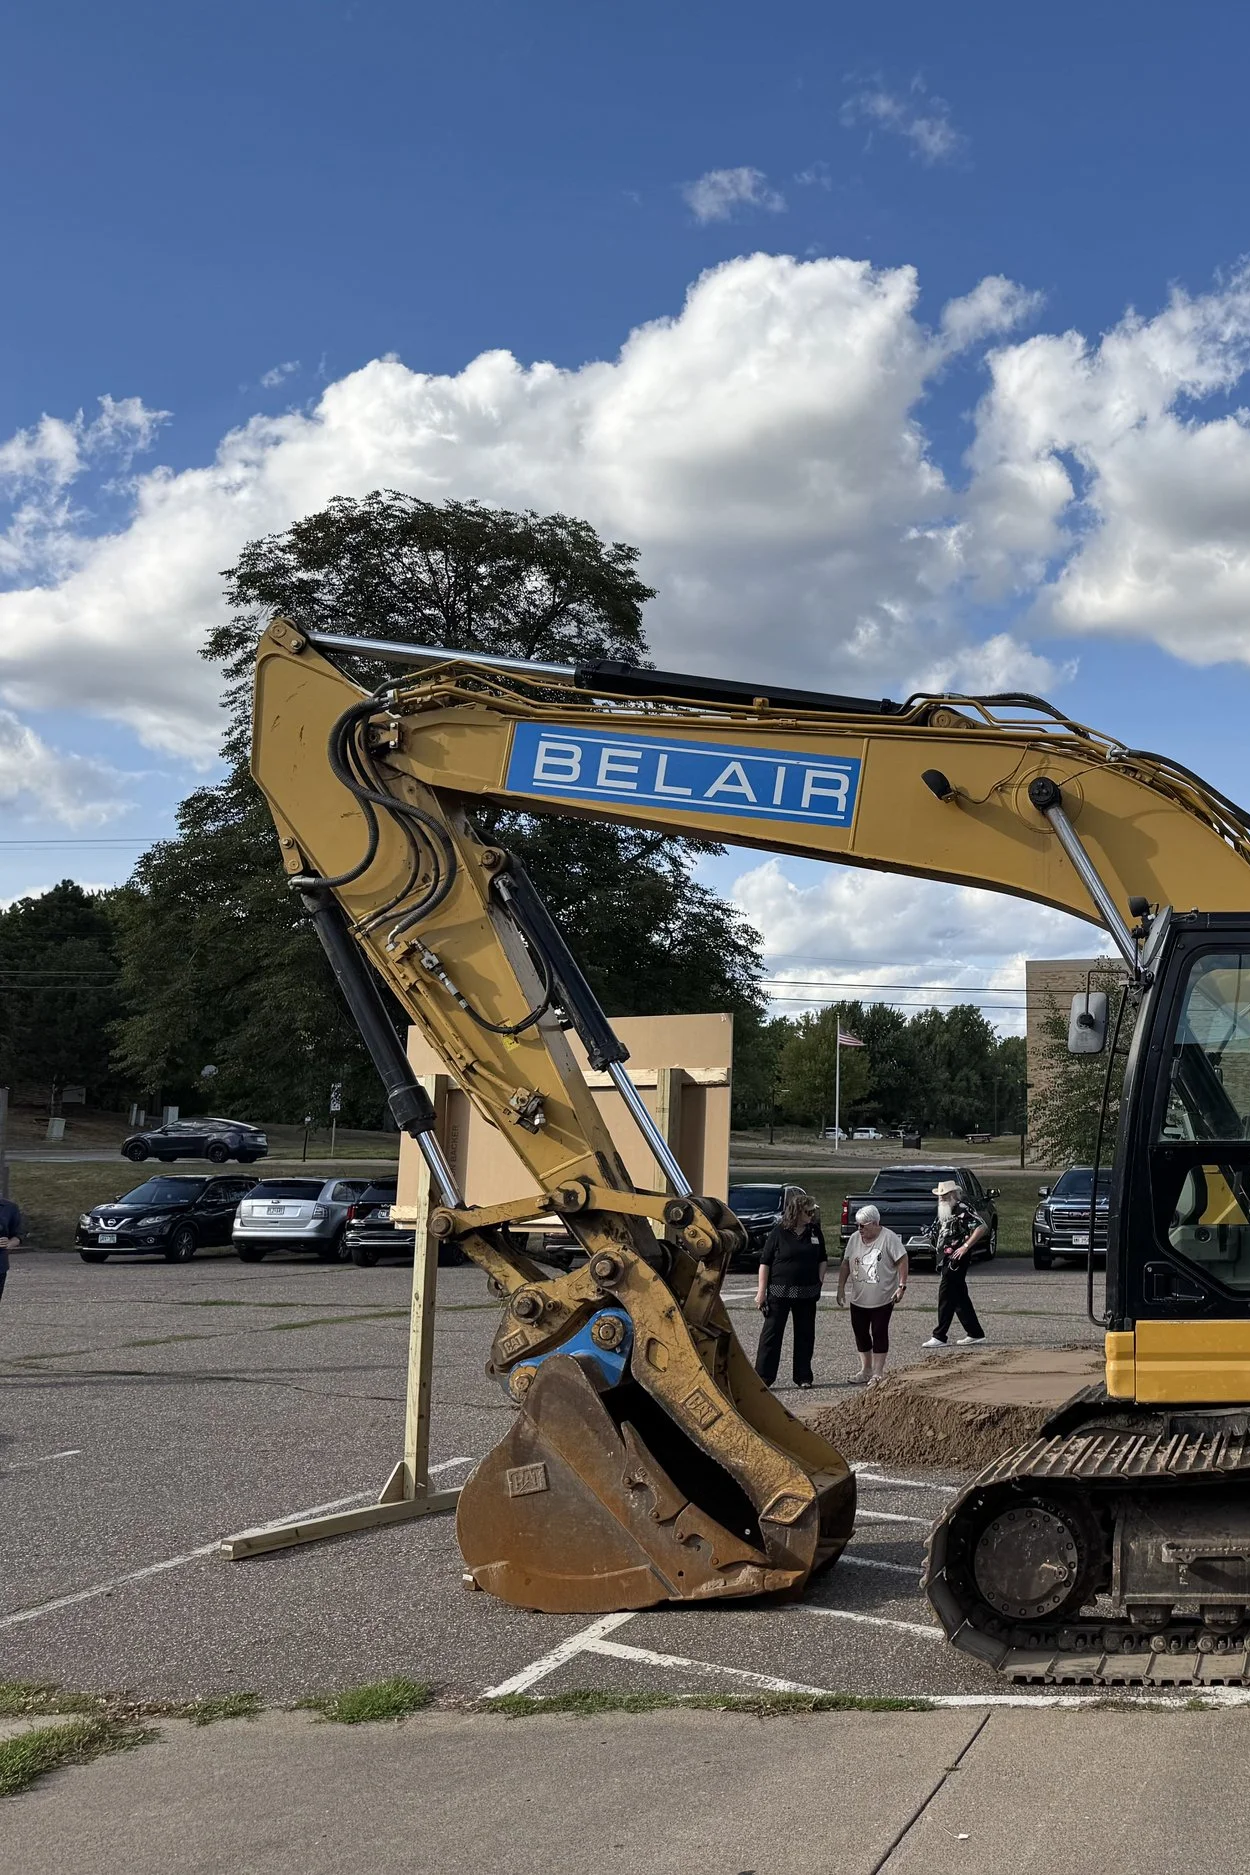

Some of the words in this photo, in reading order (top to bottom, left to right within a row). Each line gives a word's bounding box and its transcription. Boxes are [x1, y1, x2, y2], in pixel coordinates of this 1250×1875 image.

[533, 741, 850, 812] BELAIR
[503, 1334, 525, 1354] CAT
[685, 1392, 718, 1425] CAT
